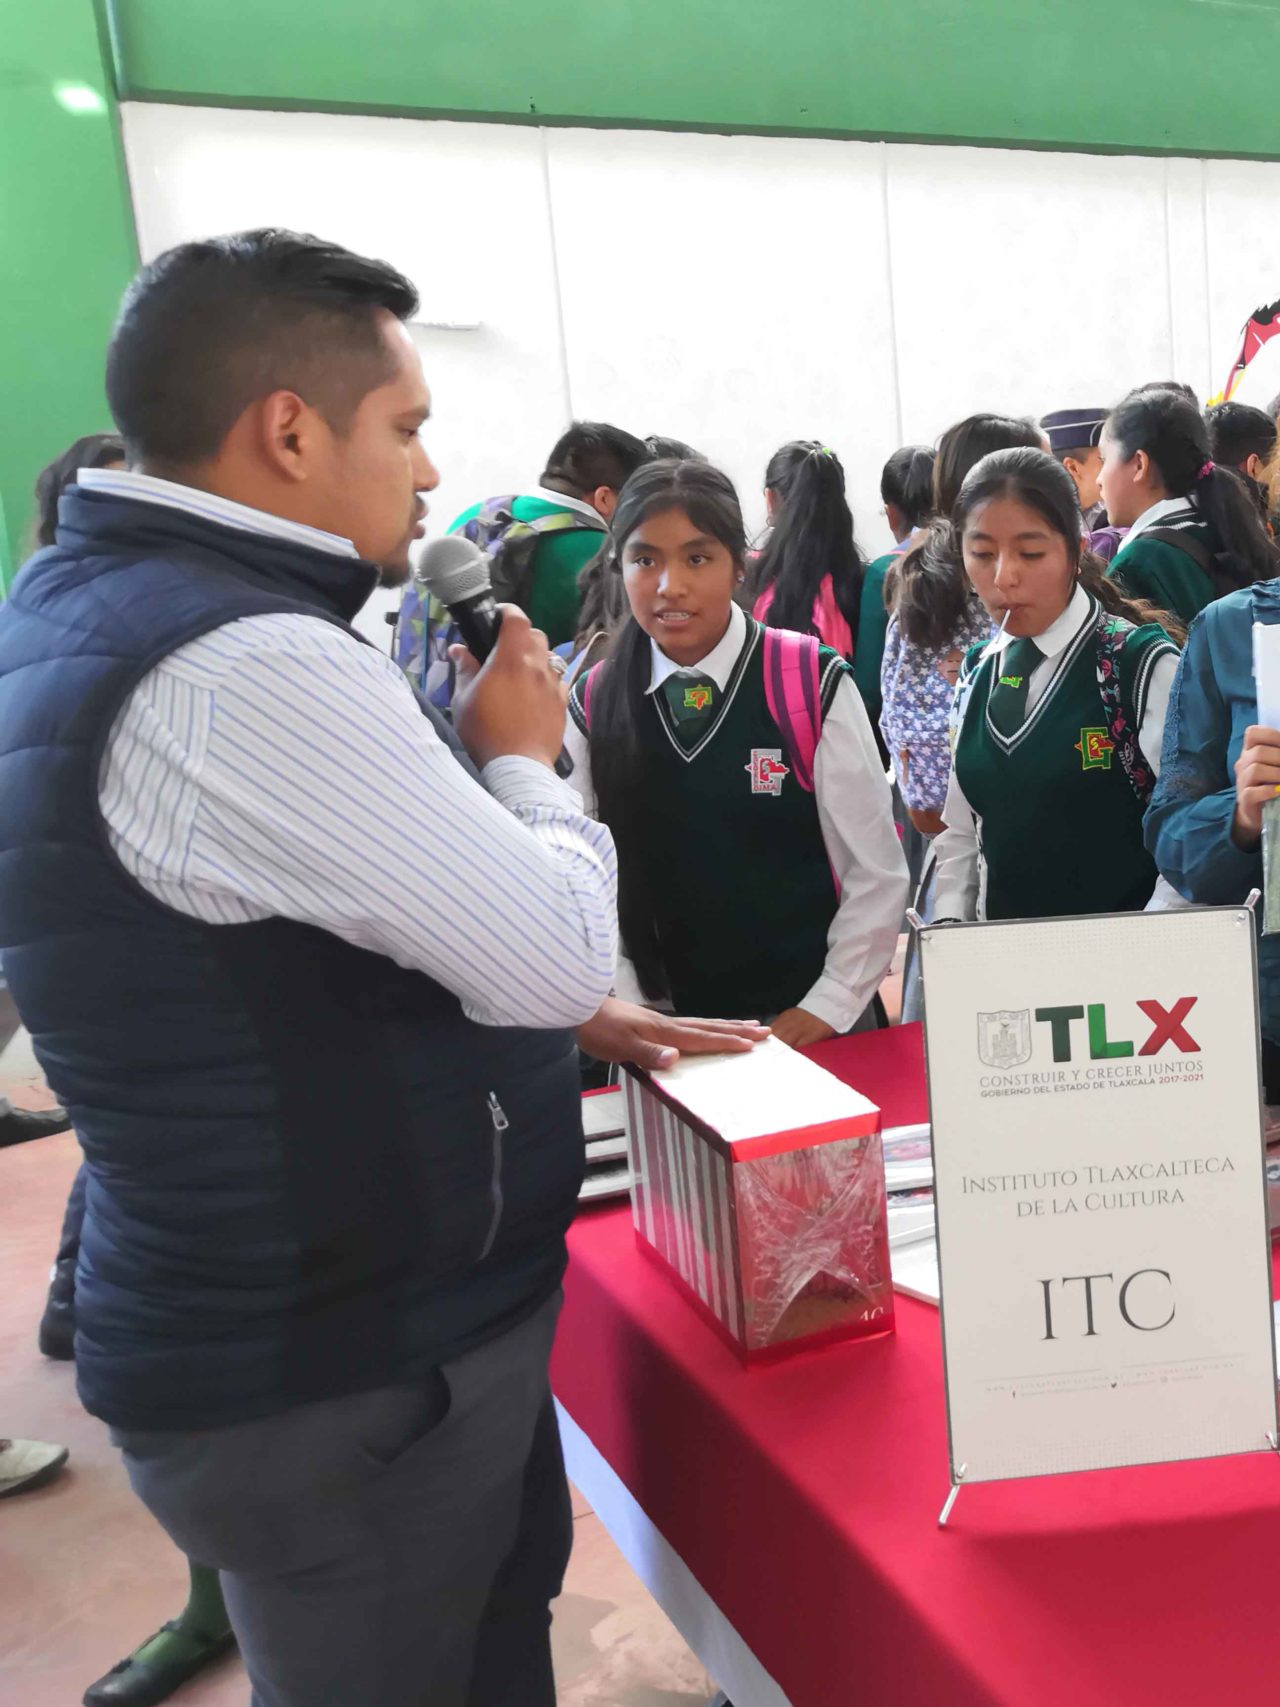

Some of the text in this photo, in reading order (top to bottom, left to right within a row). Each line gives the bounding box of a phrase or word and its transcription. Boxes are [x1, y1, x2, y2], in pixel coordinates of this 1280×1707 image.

[1034, 996, 1202, 1063] TLX
[979, 1060, 1203, 1089] CONSTRUIR Y CRECER JUNTOS
[980, 1073, 1204, 1098] GOBIERNO DEL ESTADO DE TLAXCALA 2017-2021
[961, 1156, 1235, 1194] INSTITUTO TLAXCALTECA
[1016, 1188, 1186, 1217] DE LA CULTURA
[1037, 1268, 1177, 1341] ITC
